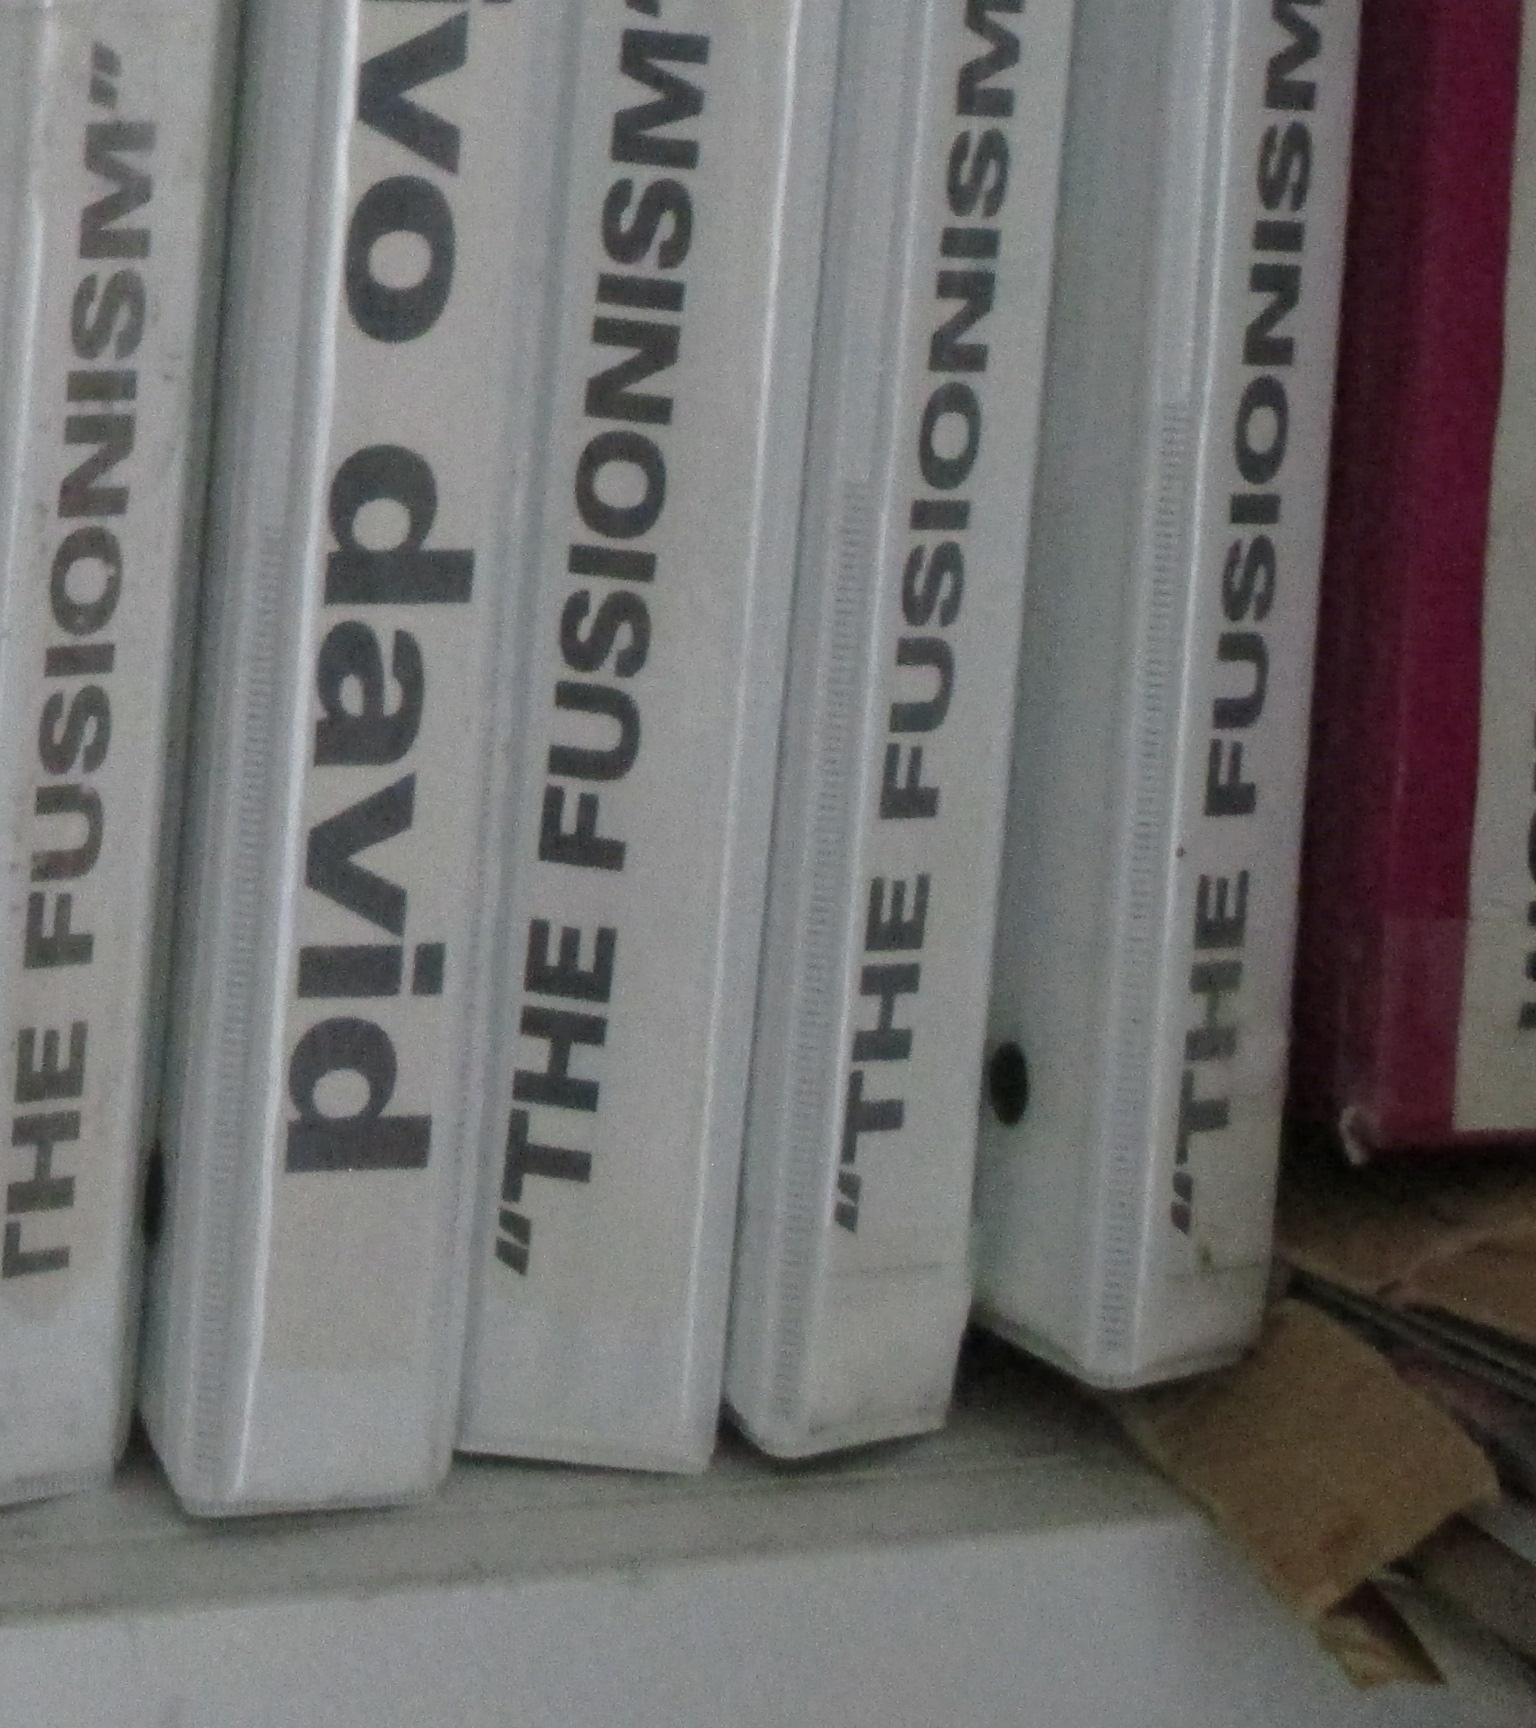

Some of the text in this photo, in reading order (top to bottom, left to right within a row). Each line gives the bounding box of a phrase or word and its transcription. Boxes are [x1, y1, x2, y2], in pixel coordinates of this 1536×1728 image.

[21, 43, 155, 971] FUSIONISM"
[284, 444, 475, 1174] david
[495, 918, 617, 1276] "THE
[834, 873, 930, 1234] "THE
[1170, 869, 1250, 1236] "THE
